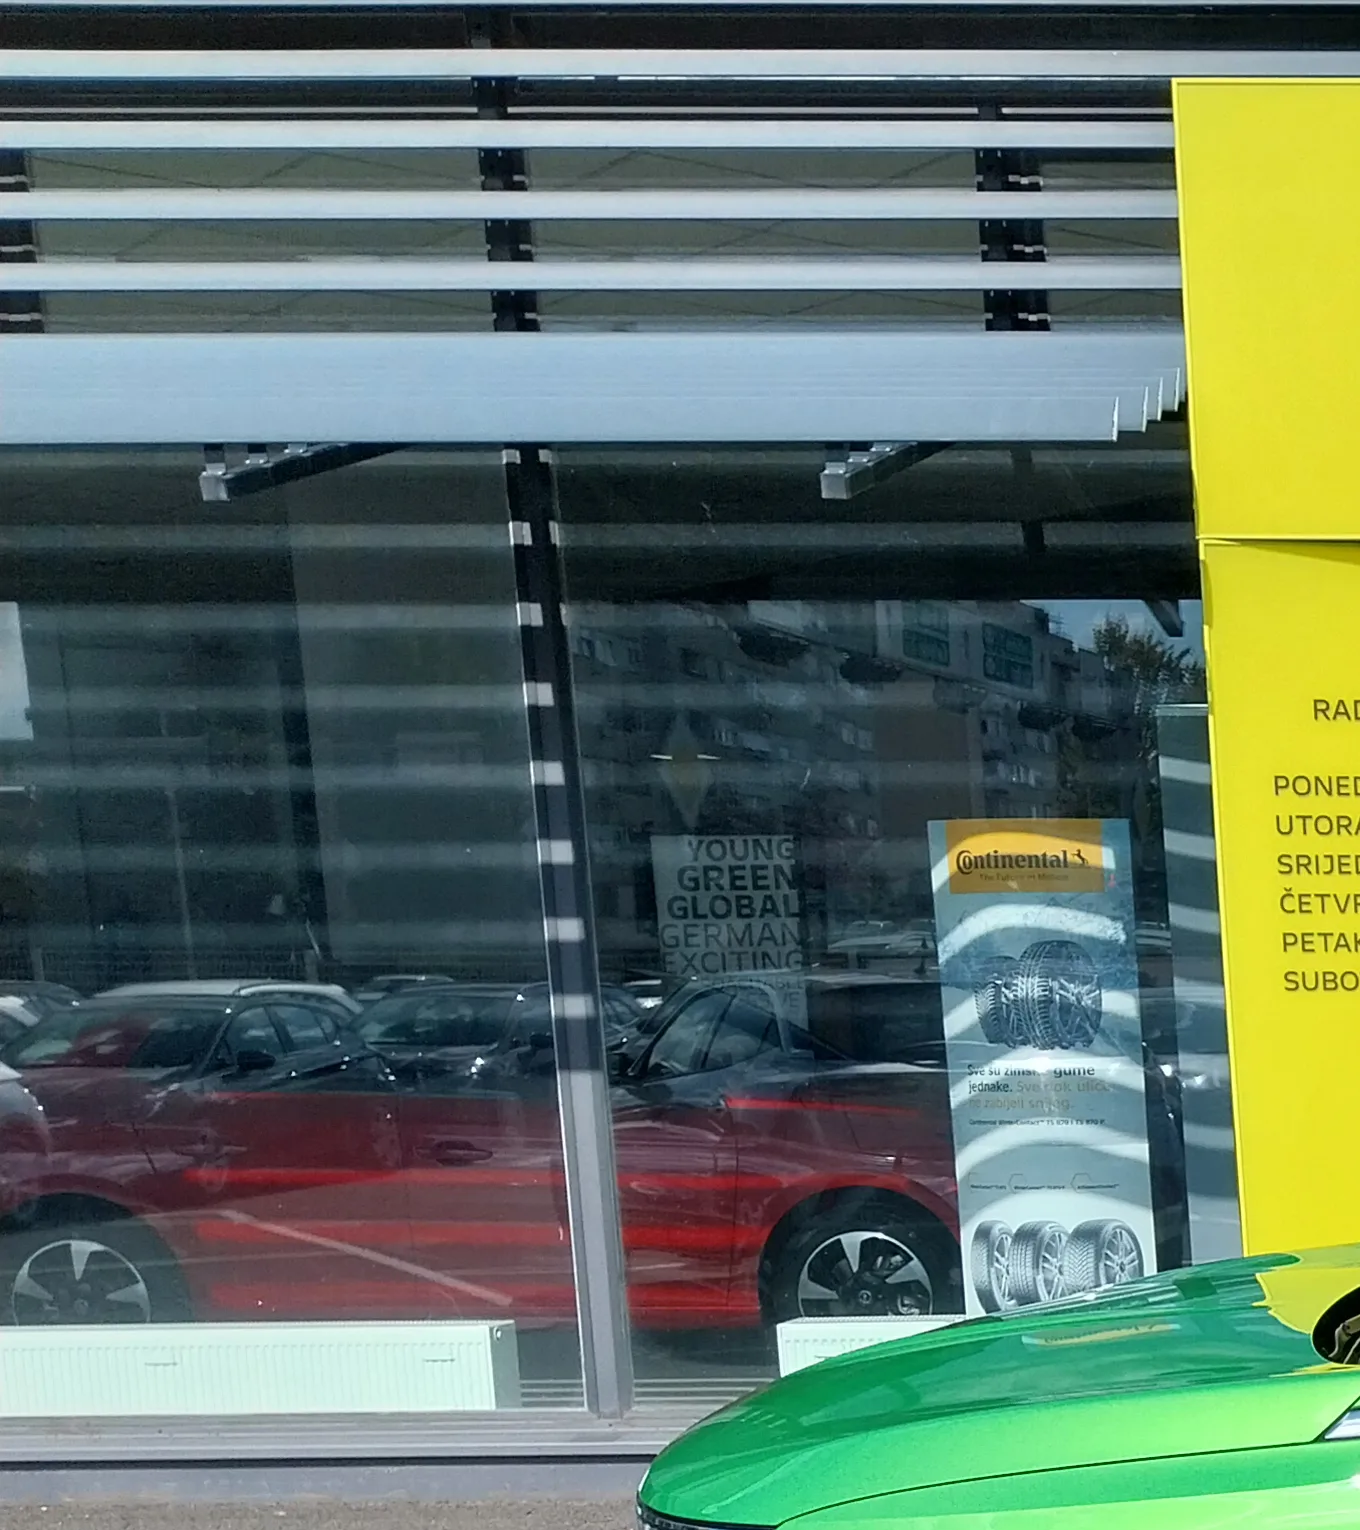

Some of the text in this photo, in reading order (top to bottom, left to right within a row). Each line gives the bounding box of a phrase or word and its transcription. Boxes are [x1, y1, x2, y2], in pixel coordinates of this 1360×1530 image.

[687, 837, 795, 863] YOUNG
[956, 849, 1069, 875] Continental
[676, 864, 799, 893] GREEN
[666, 893, 802, 921] GLOBAL
[659, 922, 802, 949] GERMAN
[662, 951, 804, 976] EXCITING
[1053, 1066, 1096, 1079] gume
[968, 1080, 1013, 1095] jednake.
